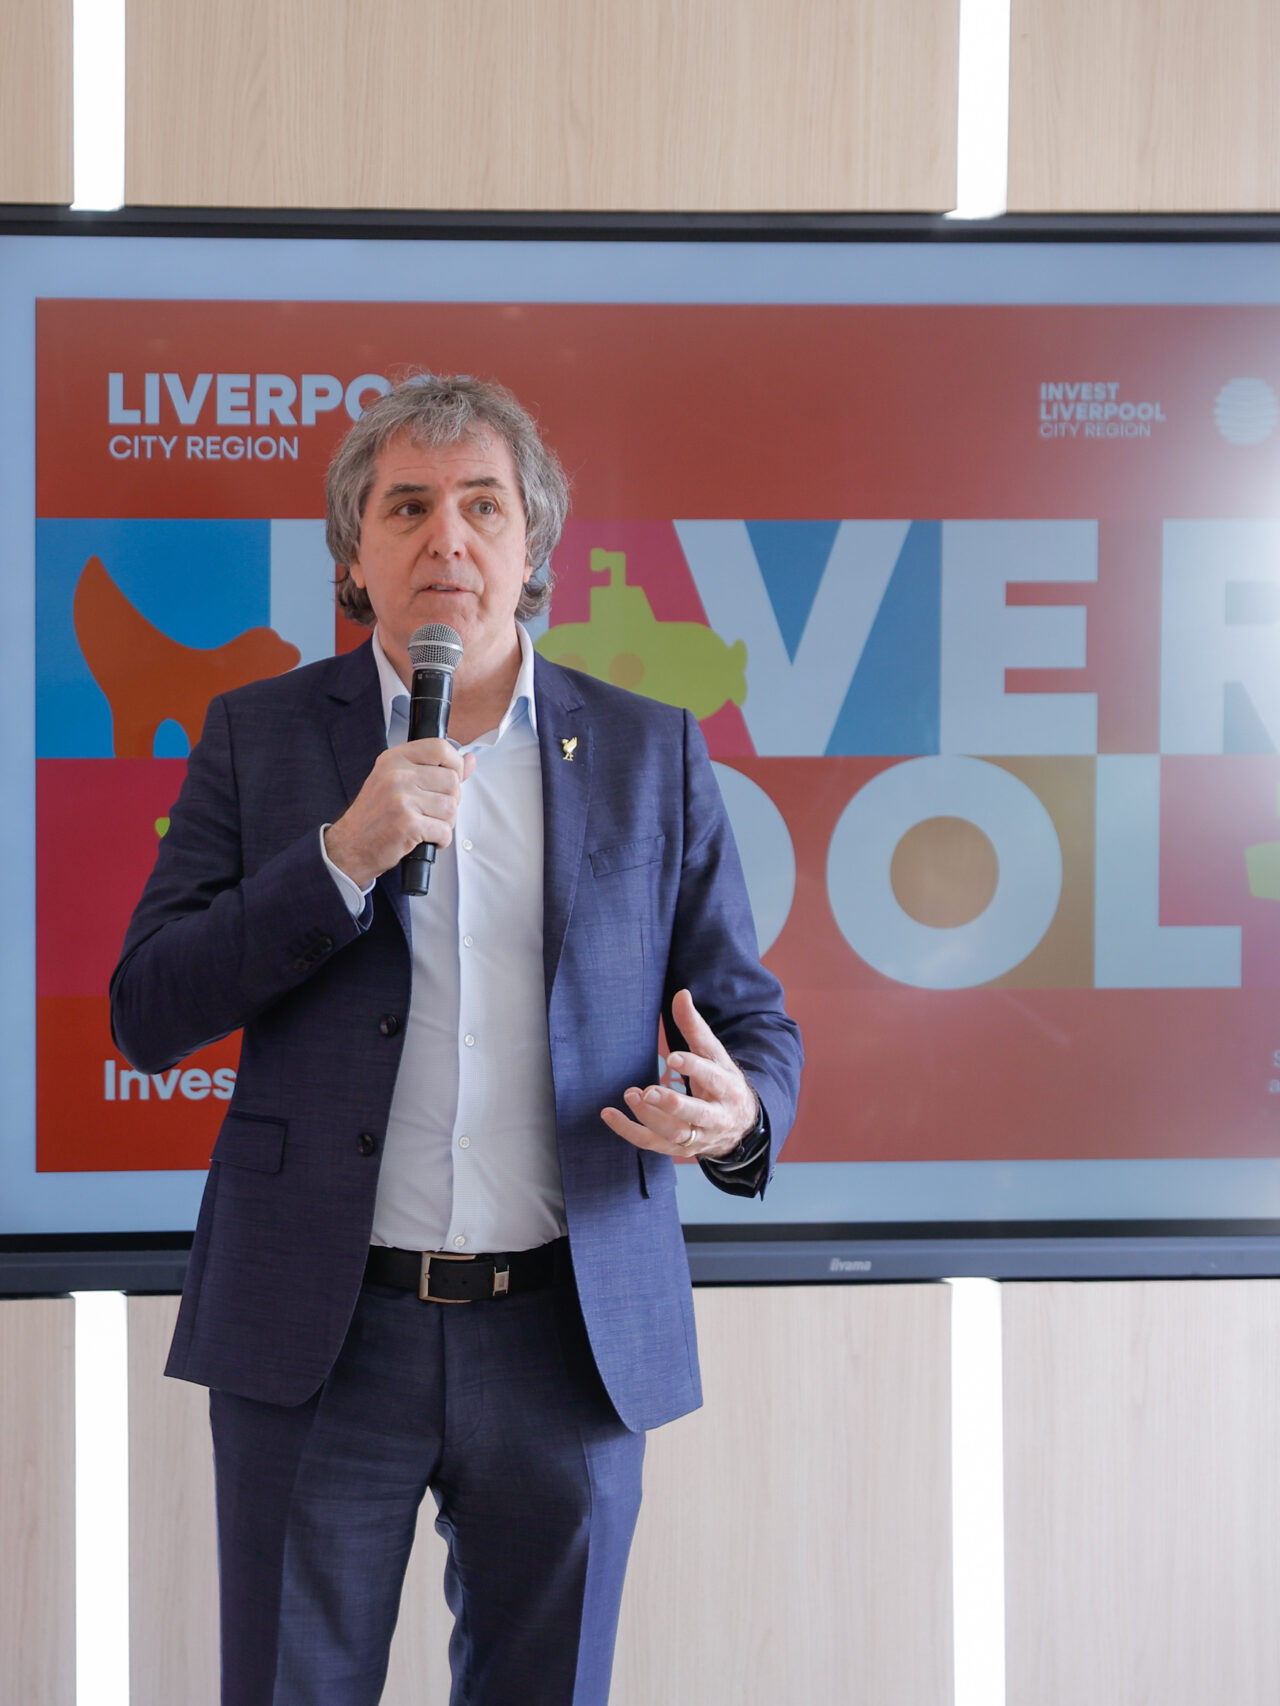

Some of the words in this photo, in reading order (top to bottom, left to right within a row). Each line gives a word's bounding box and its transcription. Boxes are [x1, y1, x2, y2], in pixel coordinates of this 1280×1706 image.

[109, 373, 472, 426] LIVERPO
[1040, 382, 1120, 401] INVEST
[1040, 402, 1167, 421] LIVERPOOL
[1040, 422, 1079, 438] CITY
[1085, 422, 1151, 438] REGION
[109, 435, 178, 460] CITY
[186, 436, 299, 460] REGION
[705, 753, 1243, 990] OL
[105, 1060, 236, 1100] Inves
